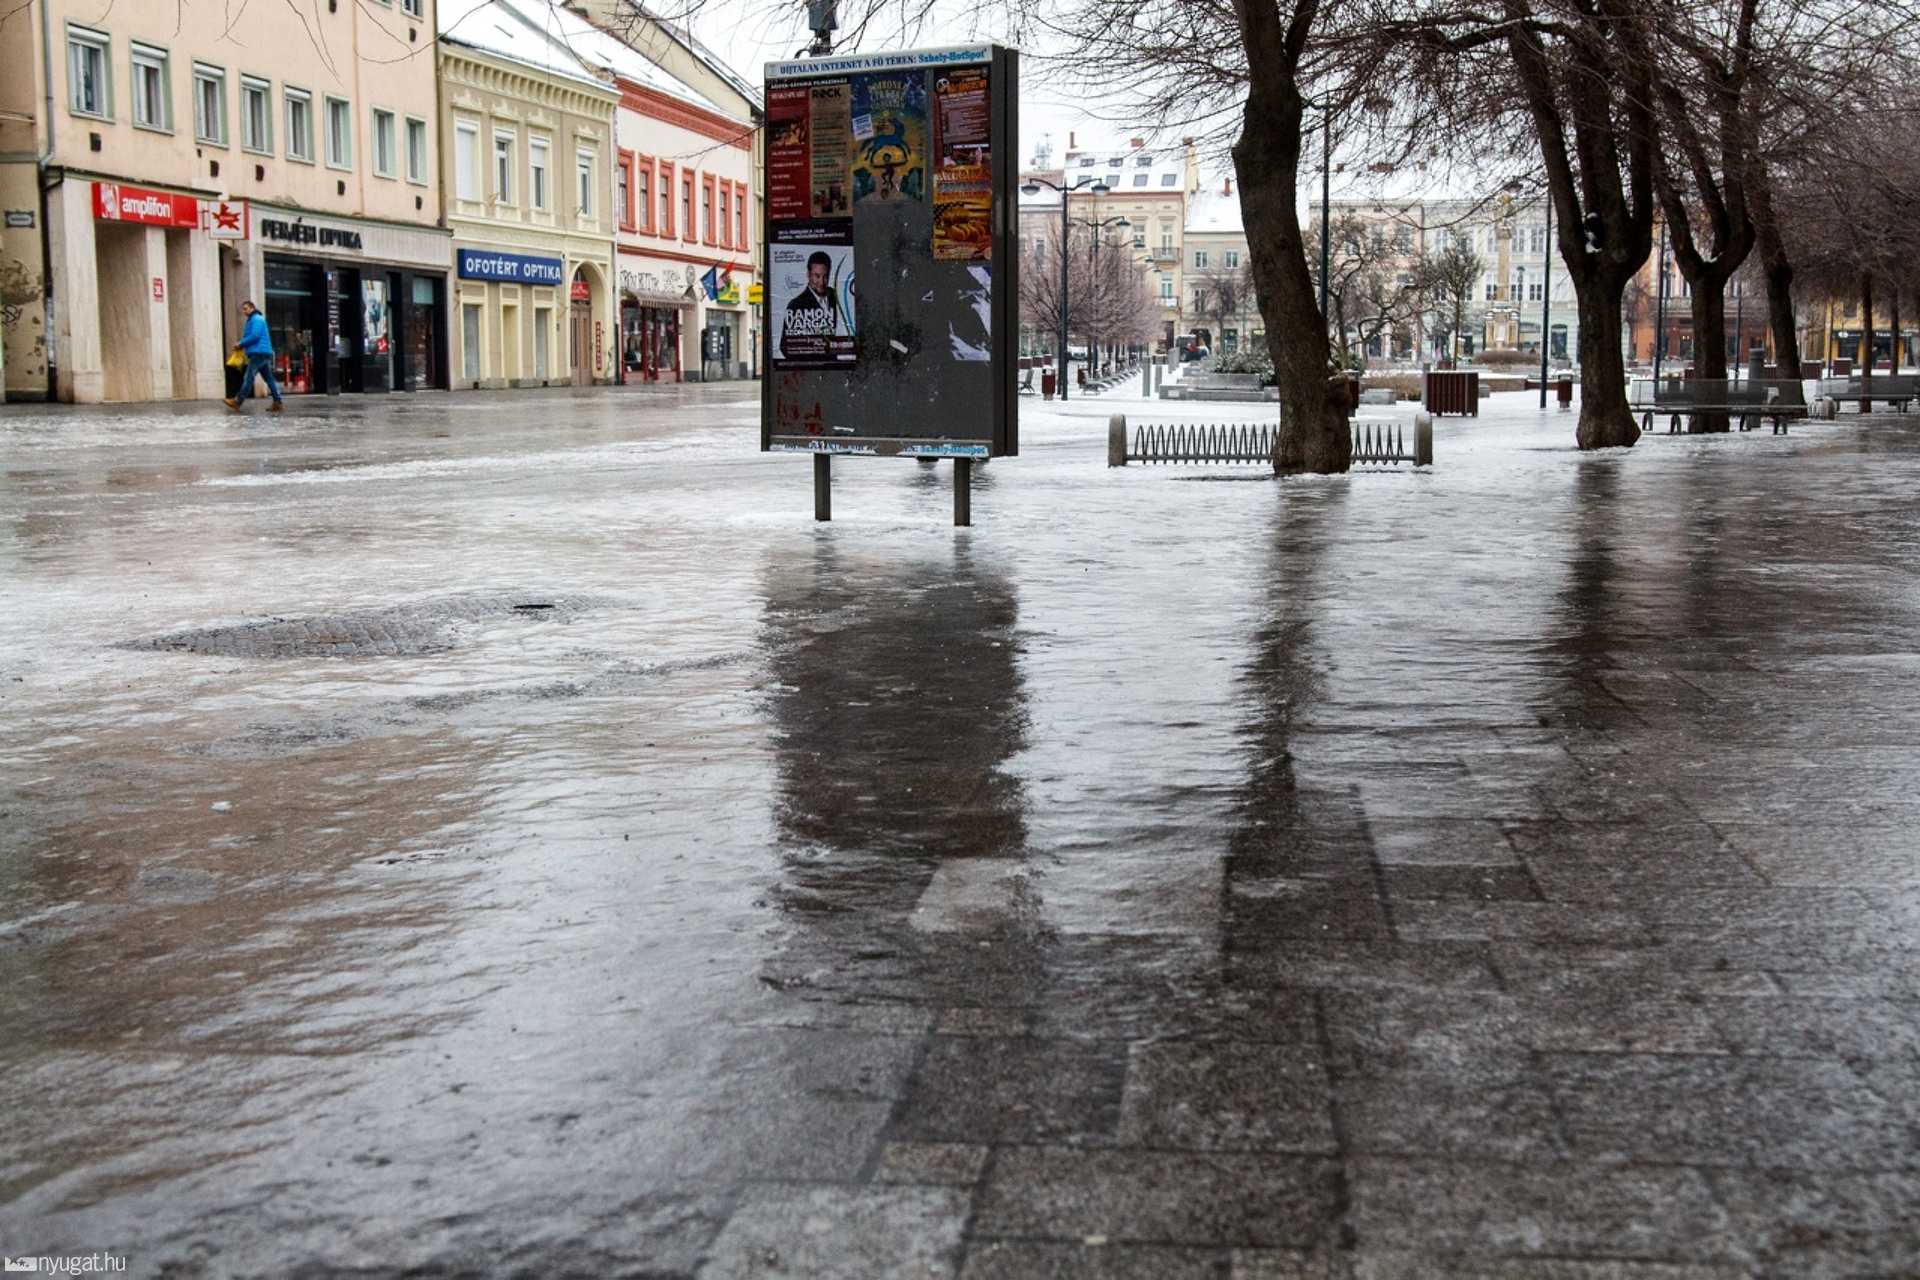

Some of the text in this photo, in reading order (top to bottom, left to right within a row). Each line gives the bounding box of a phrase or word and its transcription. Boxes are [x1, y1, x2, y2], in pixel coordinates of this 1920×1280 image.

[820, 59, 863, 72] INTERNET
[122, 196, 171, 219] amplifon
[466, 256, 561, 280] OFOTÉRT OPTIKA
[785, 319, 835, 330] VARGAS
